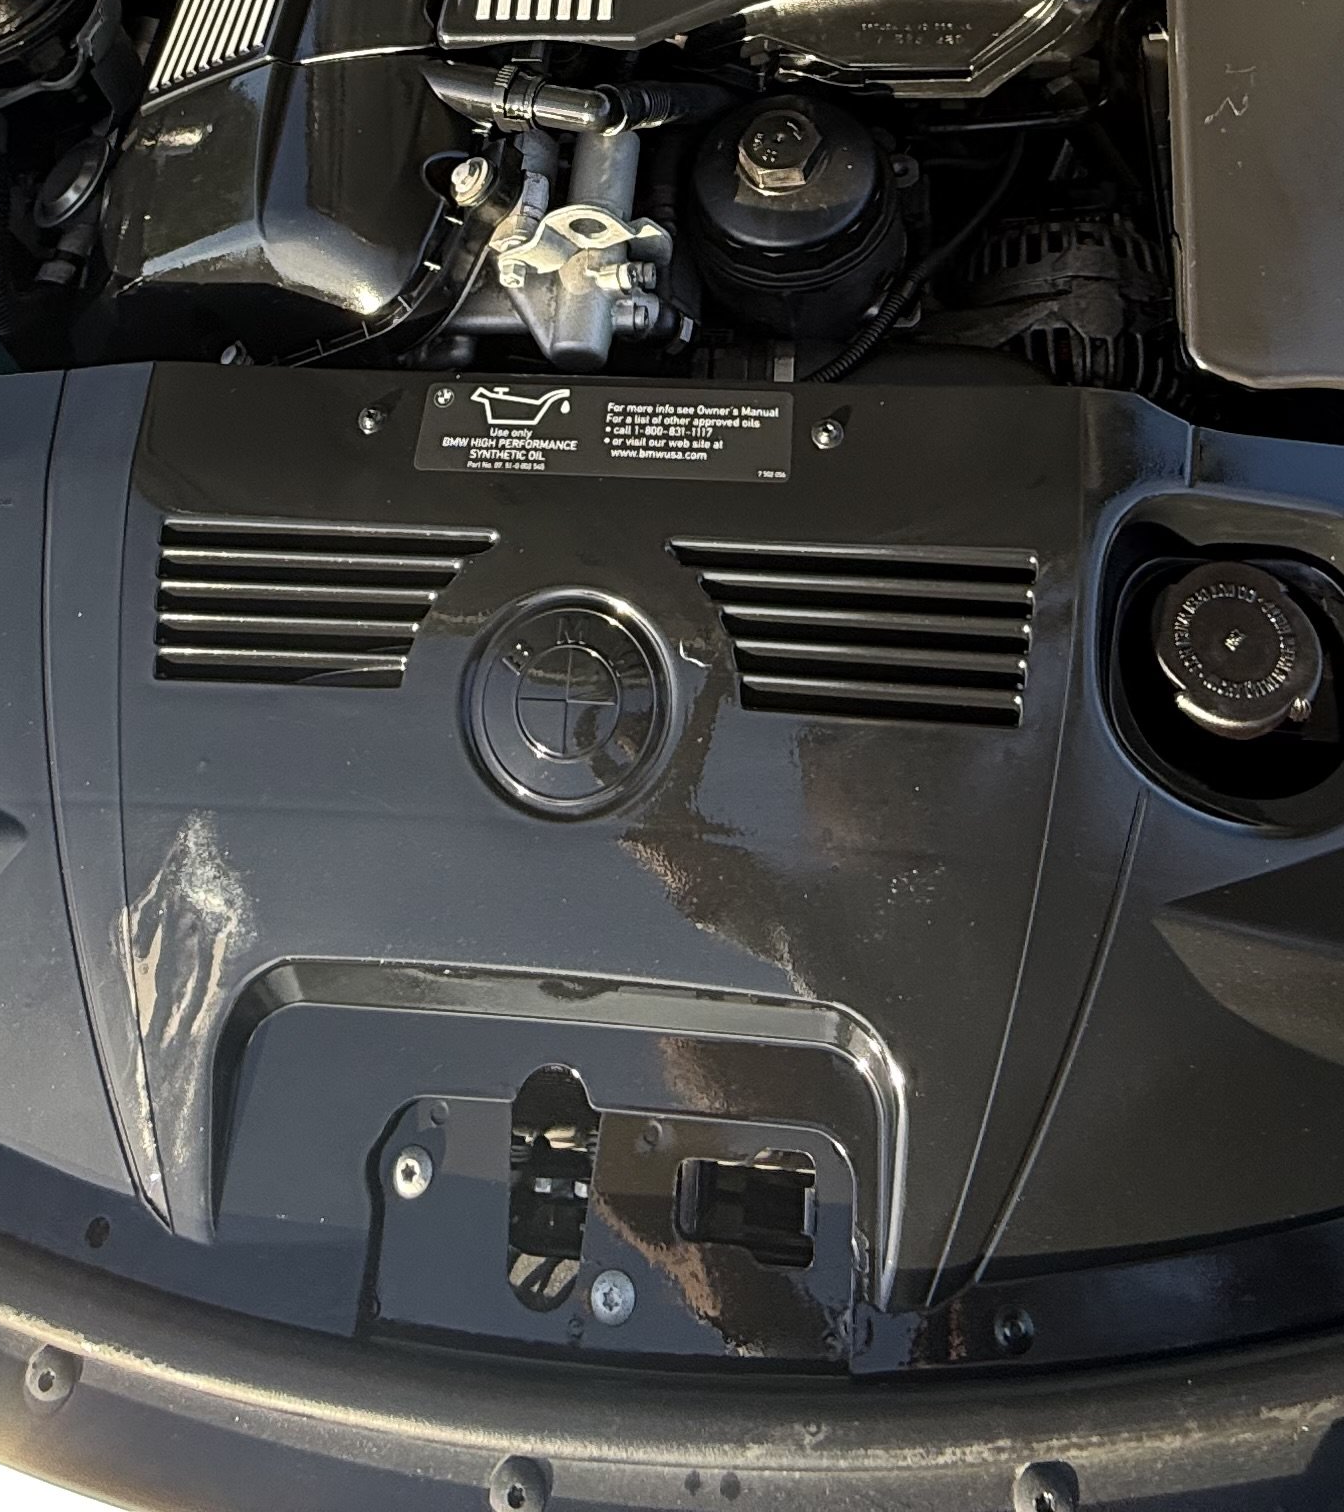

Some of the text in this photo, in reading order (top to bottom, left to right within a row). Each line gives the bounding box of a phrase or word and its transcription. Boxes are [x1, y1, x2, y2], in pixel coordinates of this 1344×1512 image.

[607, 402, 779, 418] For more info see Owner's Manual
[606, 413, 761, 428] For a list of other approved oils
[489, 427, 534, 440] Use only
[613, 425, 632, 435] call
[442, 436, 578, 451] BMW HIGH PERFORMANCE
[612, 436, 723, 450] or visit our web site at
[469, 448, 546, 461] SYNTHETIC OIL
[610, 448, 708, 460] www.bmwusa.com
